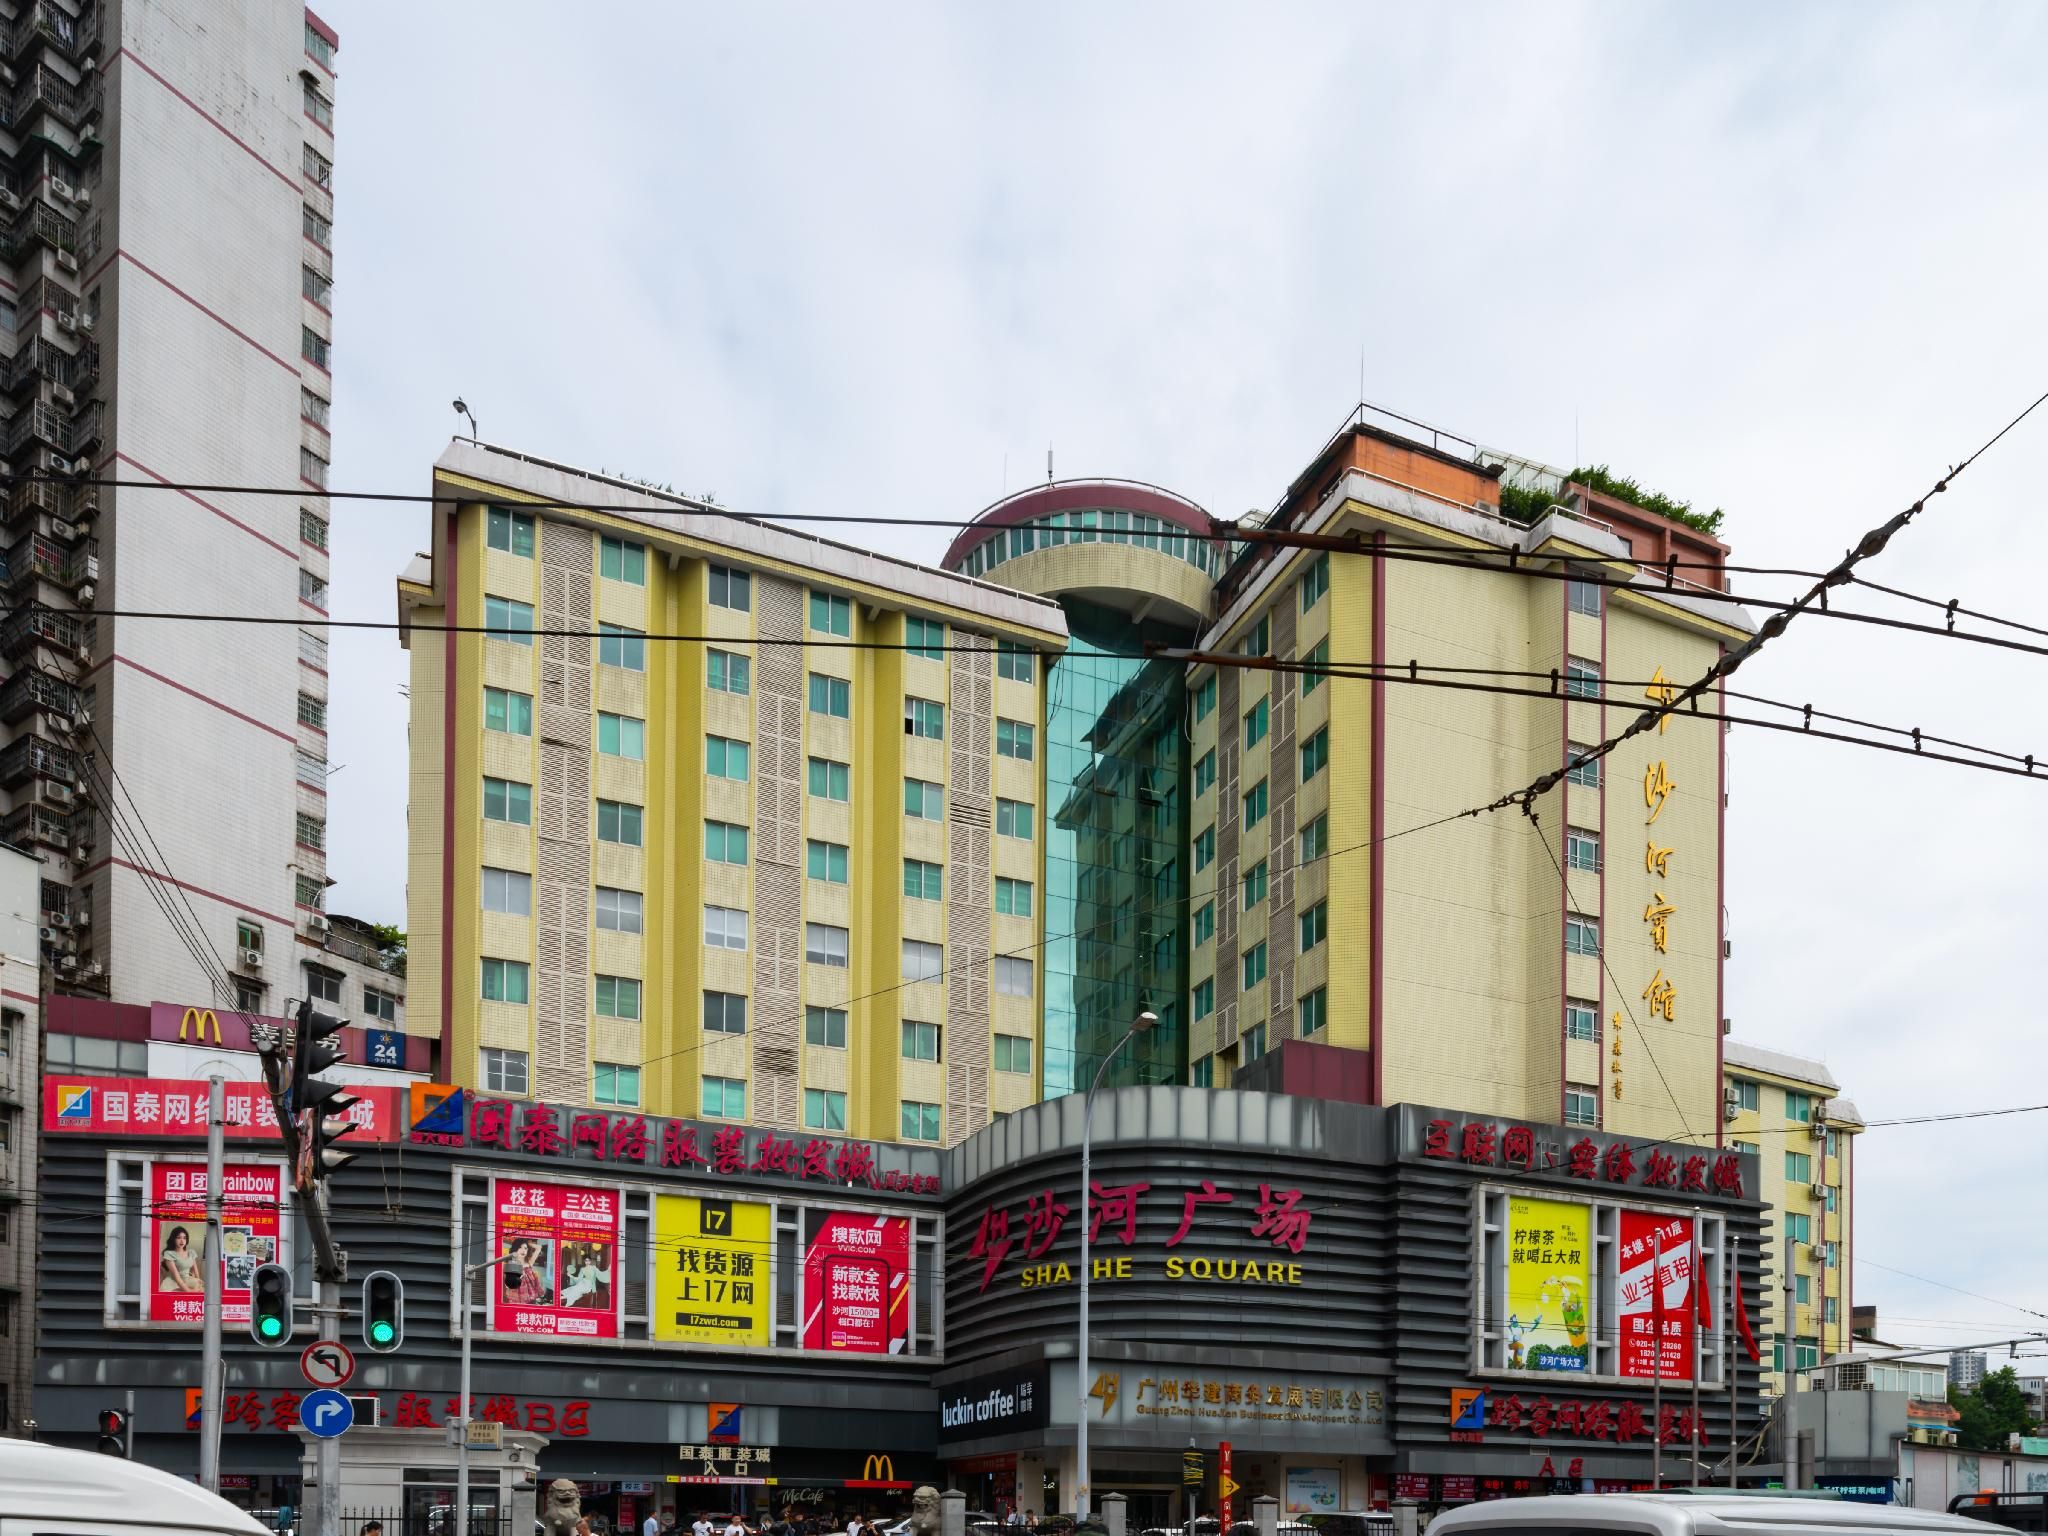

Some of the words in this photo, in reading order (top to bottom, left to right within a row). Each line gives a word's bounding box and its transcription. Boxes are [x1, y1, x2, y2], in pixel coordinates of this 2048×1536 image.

[374, 1044, 397, 1059] 24
[103, 1091, 375, 1130] 国泰网络服装城
[1423, 1119, 1745, 1199] 互联网、实体批发城
[510, 1187, 545, 1207] 校花
[565, 1193, 611, 1213] 三公主
[706, 1209, 726, 1230] 17
[1022, 1179, 1311, 1254] 沙河广场
[832, 1226, 882, 1247] 搜款网
[1514, 1229, 1555, 1246] 柠檬茶
[838, 1245, 875, 1254] VVIC.COM
[1512, 1248, 1581, 1265] 就喝丘大叔
[1621, 1238, 1644, 1259] 本楼
[677, 1248, 754, 1277] 找货源
[1021, 1262, 1072, 1289] SHA
[1093, 1257, 1132, 1279] HE
[1165, 1256, 1303, 1285] SQUARE
[832, 1265, 880, 1285] 新款全
[677, 1276, 754, 1305] 上17网
[832, 1283, 880, 1303] 找款快
[173, 1300, 205, 1314] 搜款
[516, 1312, 556, 1328] 搜款网
[690, 1315, 738, 1328] 17zwd.com
[1137, 1379, 1384, 1411] 广州华建商务发展有限公司
[942, 1396, 974, 1428] luckin
[976, 1388, 1014, 1421] coffee
[680, 1445, 770, 1463] 国泰服装城
[704, 1461, 748, 1476] 入口
[782, 1488, 824, 1504] McCafé
